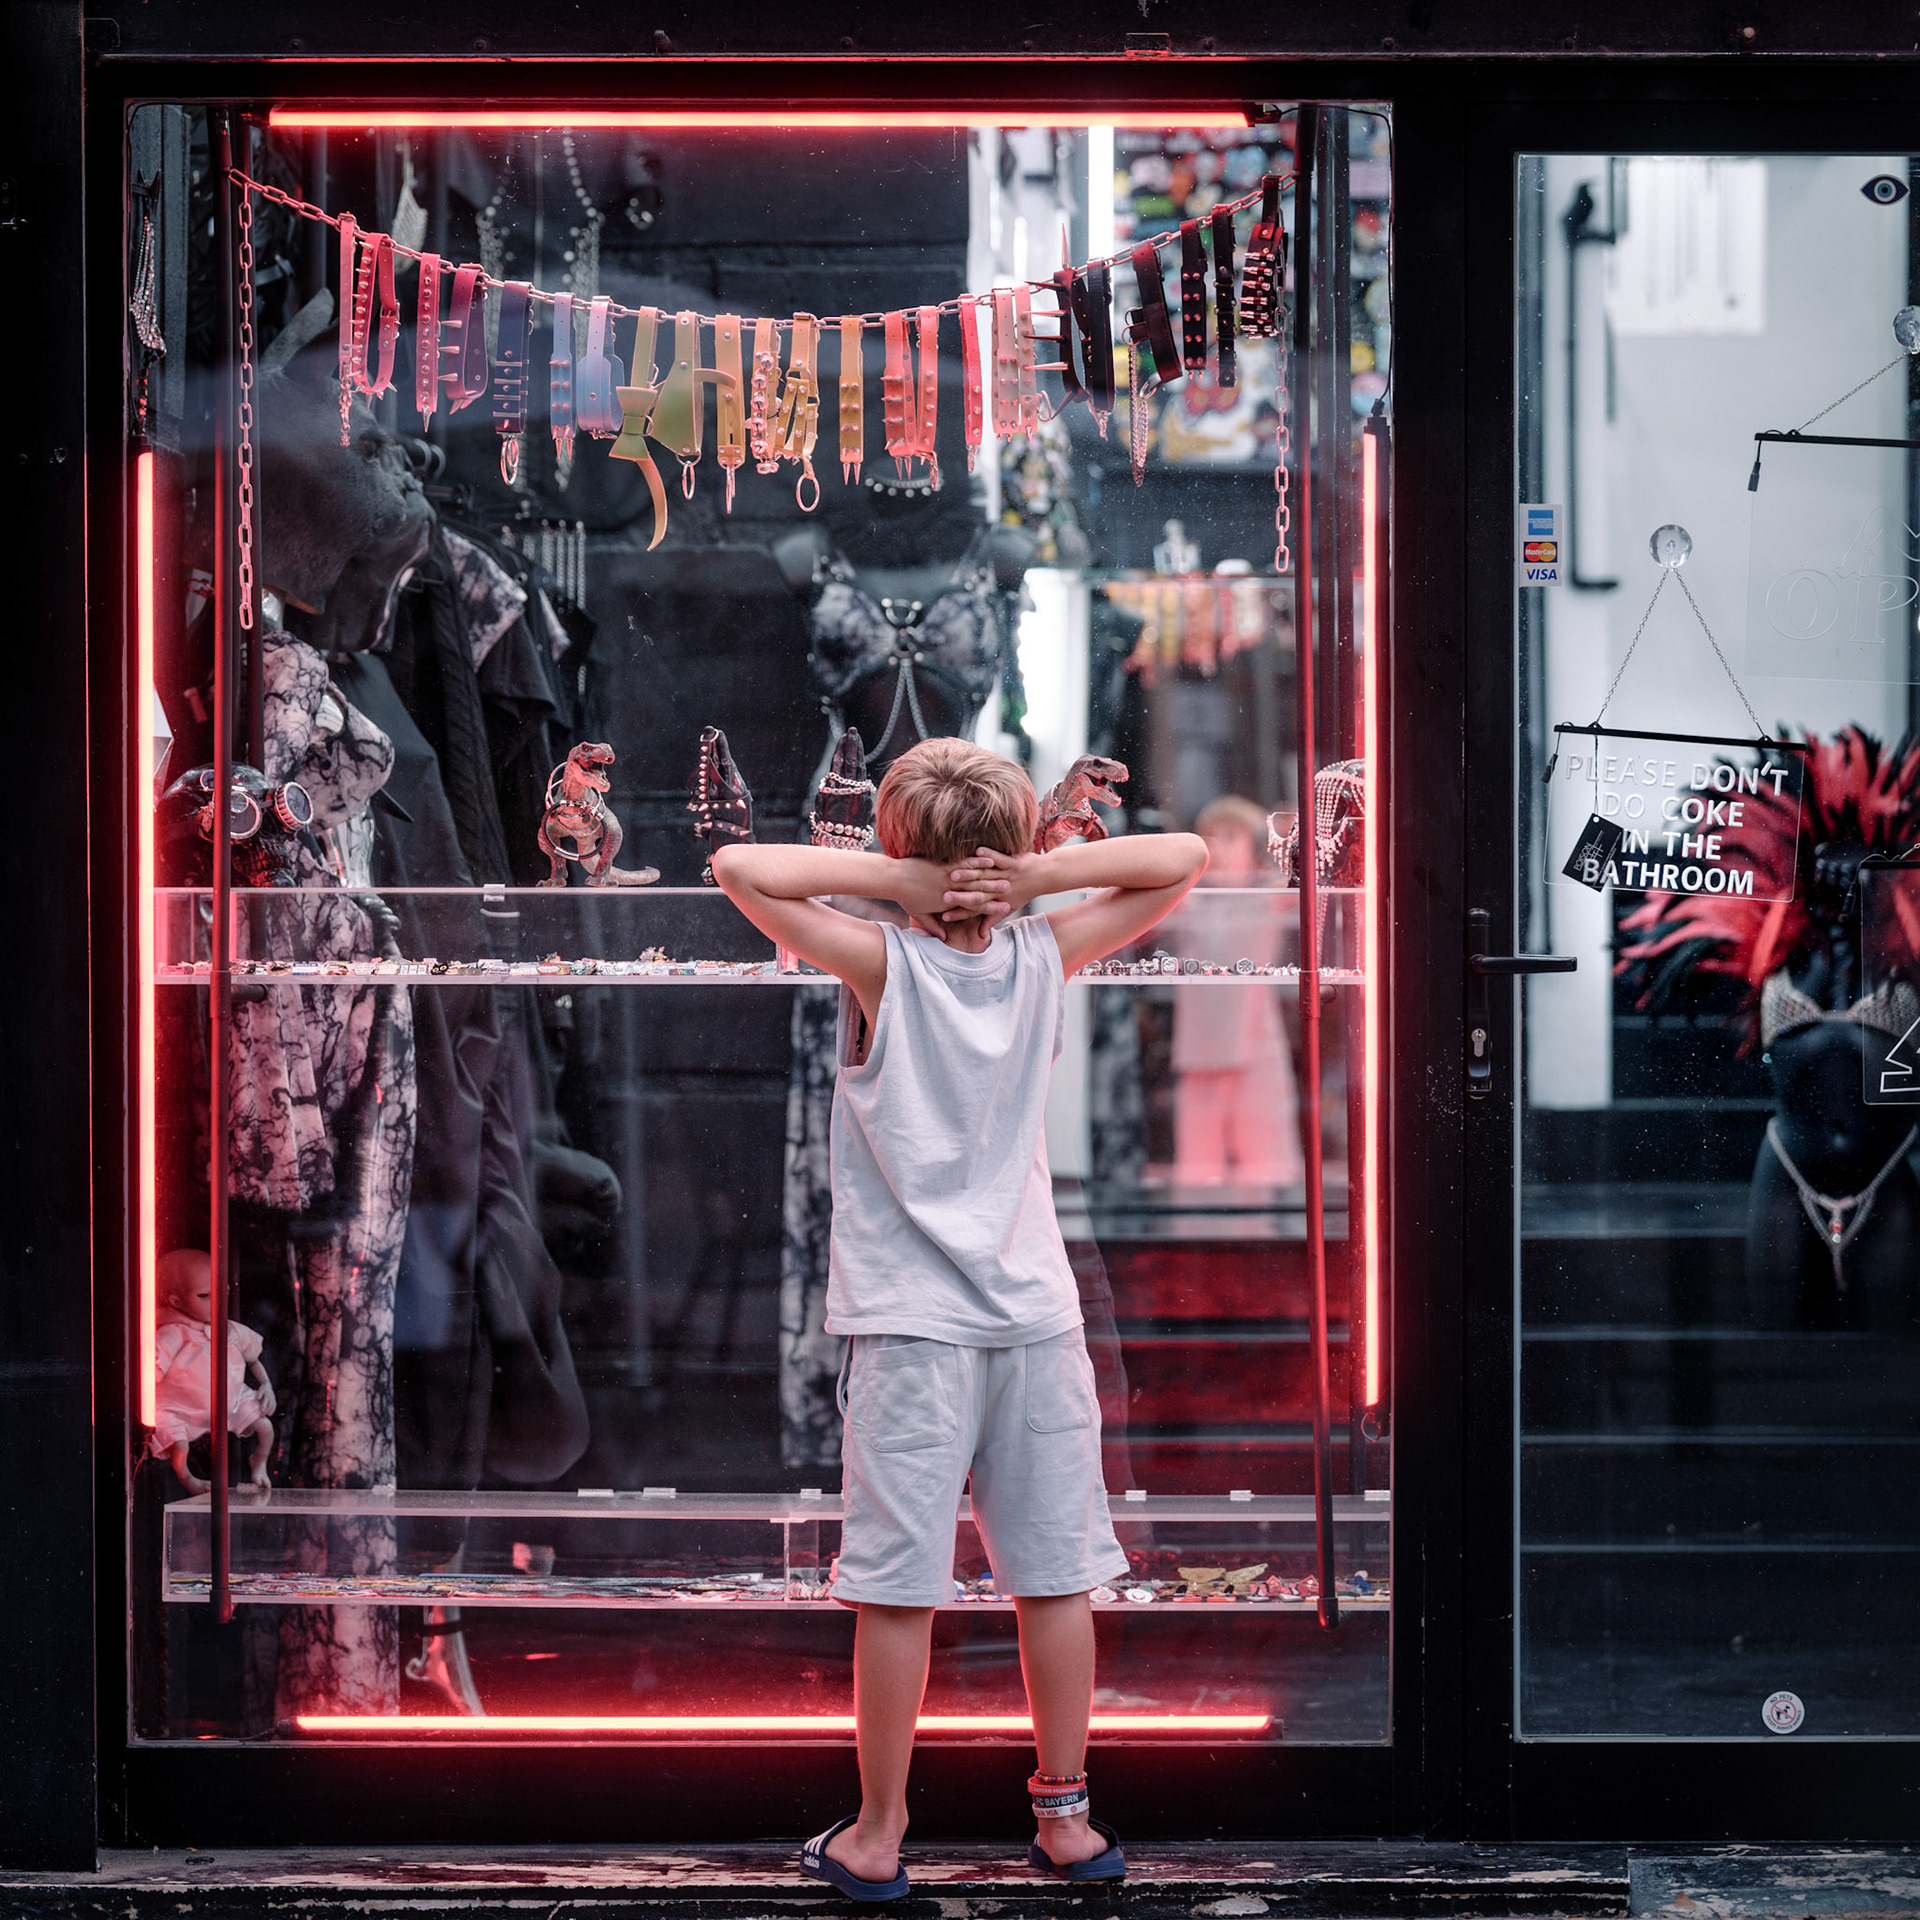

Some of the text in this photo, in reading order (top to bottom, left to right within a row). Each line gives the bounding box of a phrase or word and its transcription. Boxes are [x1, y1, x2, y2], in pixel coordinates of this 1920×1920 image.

[1525, 569, 1557, 580] VISA
[1566, 753, 1789, 796] PLEASE DON'T
[1602, 791, 1745, 827] DO COKE
[1620, 828, 1650, 855] IN
[1662, 831, 1723, 860] THE
[1582, 858, 1754, 896] BATHROOM
[1770, 1696, 1778, 1704] NO
[1036, 1797, 1044, 1805] FC
[1044, 1793, 1079, 1807] BAYERN
[803, 1855, 820, 1869] adidas
